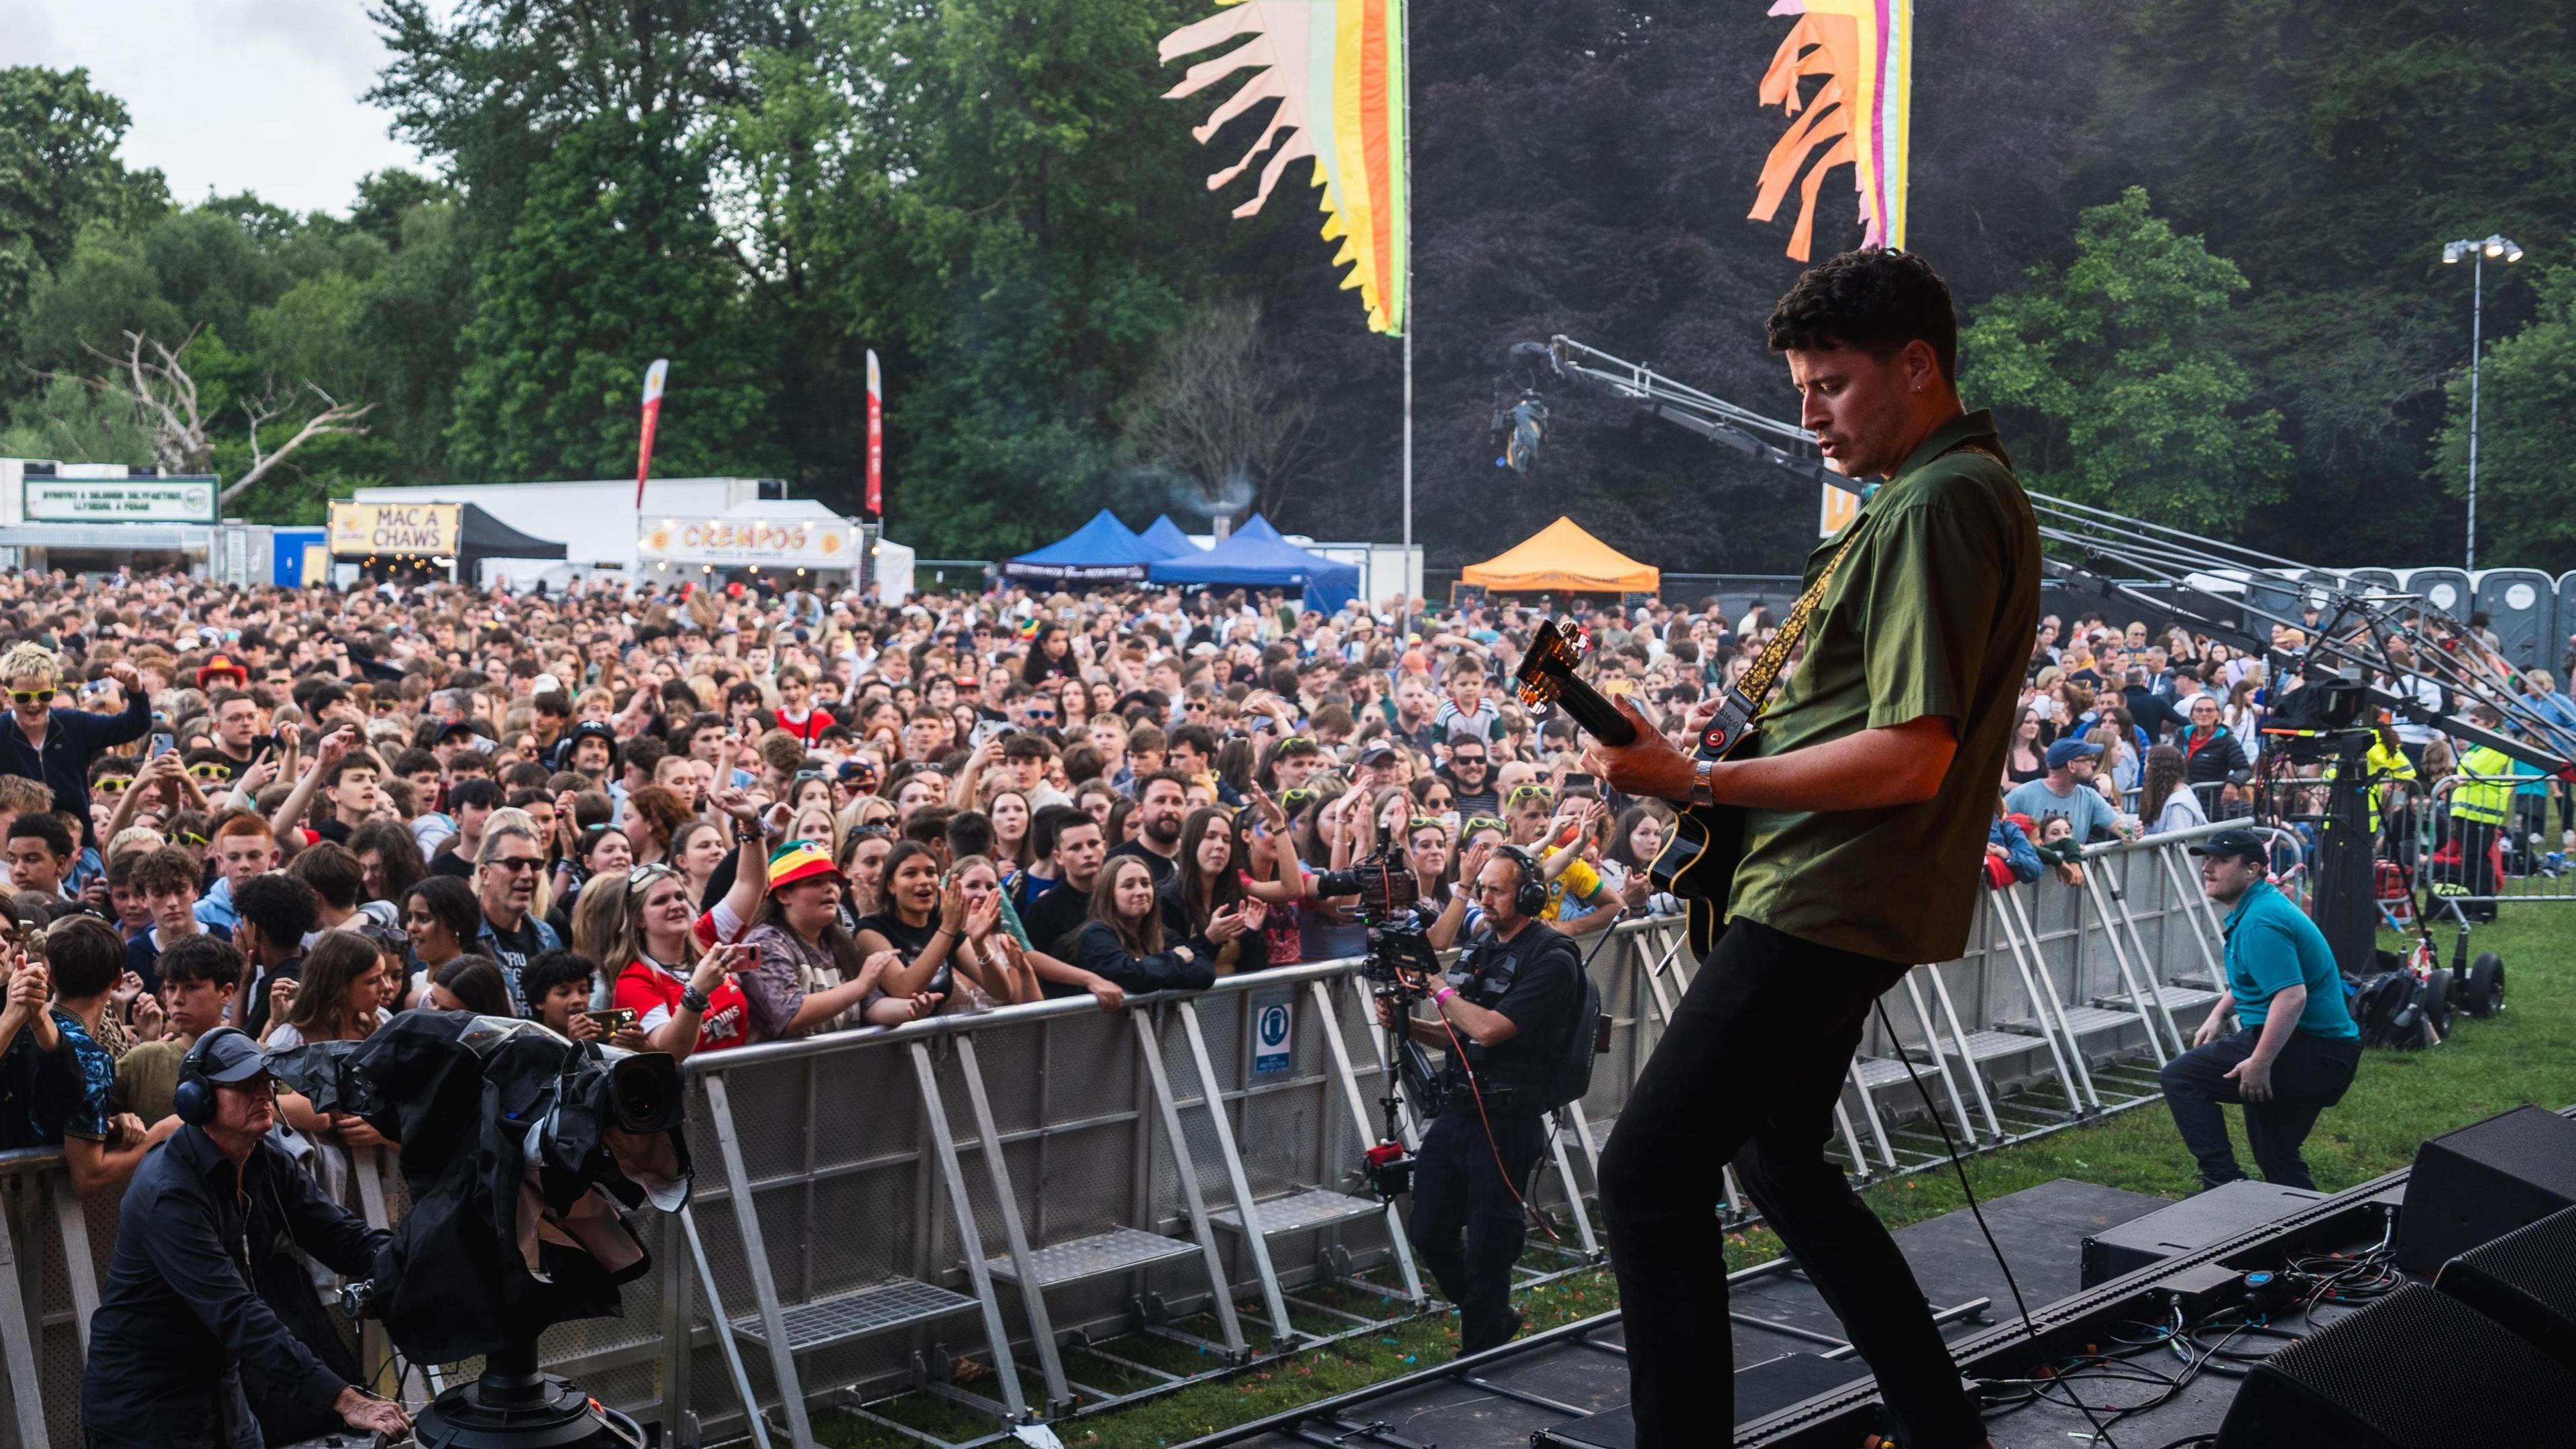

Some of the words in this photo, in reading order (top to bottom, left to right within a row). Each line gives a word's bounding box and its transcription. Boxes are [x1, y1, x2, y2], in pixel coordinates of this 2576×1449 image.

[377, 507, 419, 527] MAC
[425, 508, 439, 526] A
[372, 528, 441, 547] CHAWS
[684, 525, 806, 549] CREMPOG
